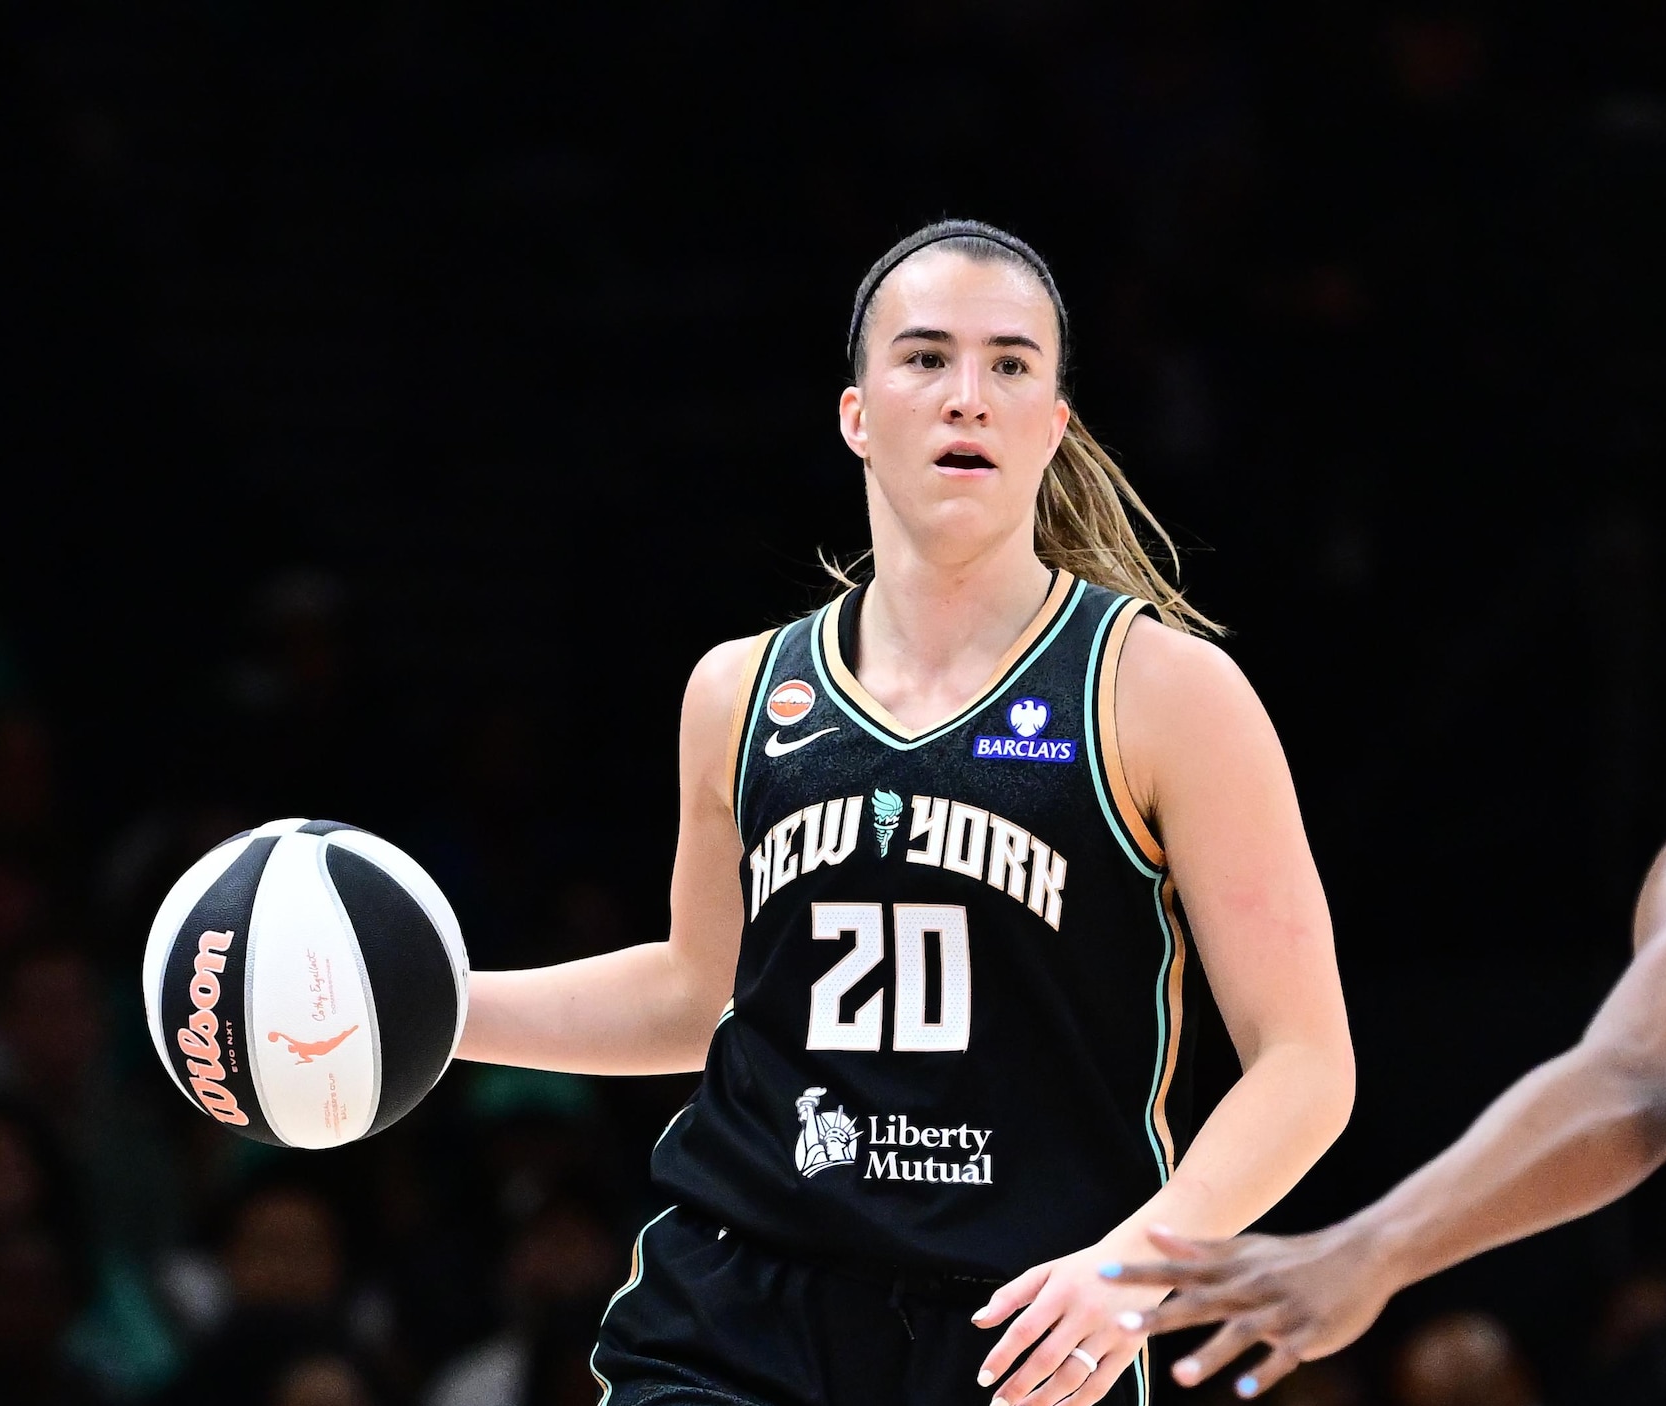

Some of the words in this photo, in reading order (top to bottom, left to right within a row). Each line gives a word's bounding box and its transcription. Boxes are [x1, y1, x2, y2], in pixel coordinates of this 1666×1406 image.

[977, 739, 1071, 759] BARCLAYS
[750, 795, 864, 923] NEW
[906, 794, 1068, 932] YORK
[806, 902, 971, 1052] 20
[177, 930, 249, 1126] Wilson
[225, 1020, 234, 1048] NXT
[227, 1050, 238, 1073] EVO
[868, 1115, 993, 1161] Liberty
[863, 1151, 993, 1184] Mutual
